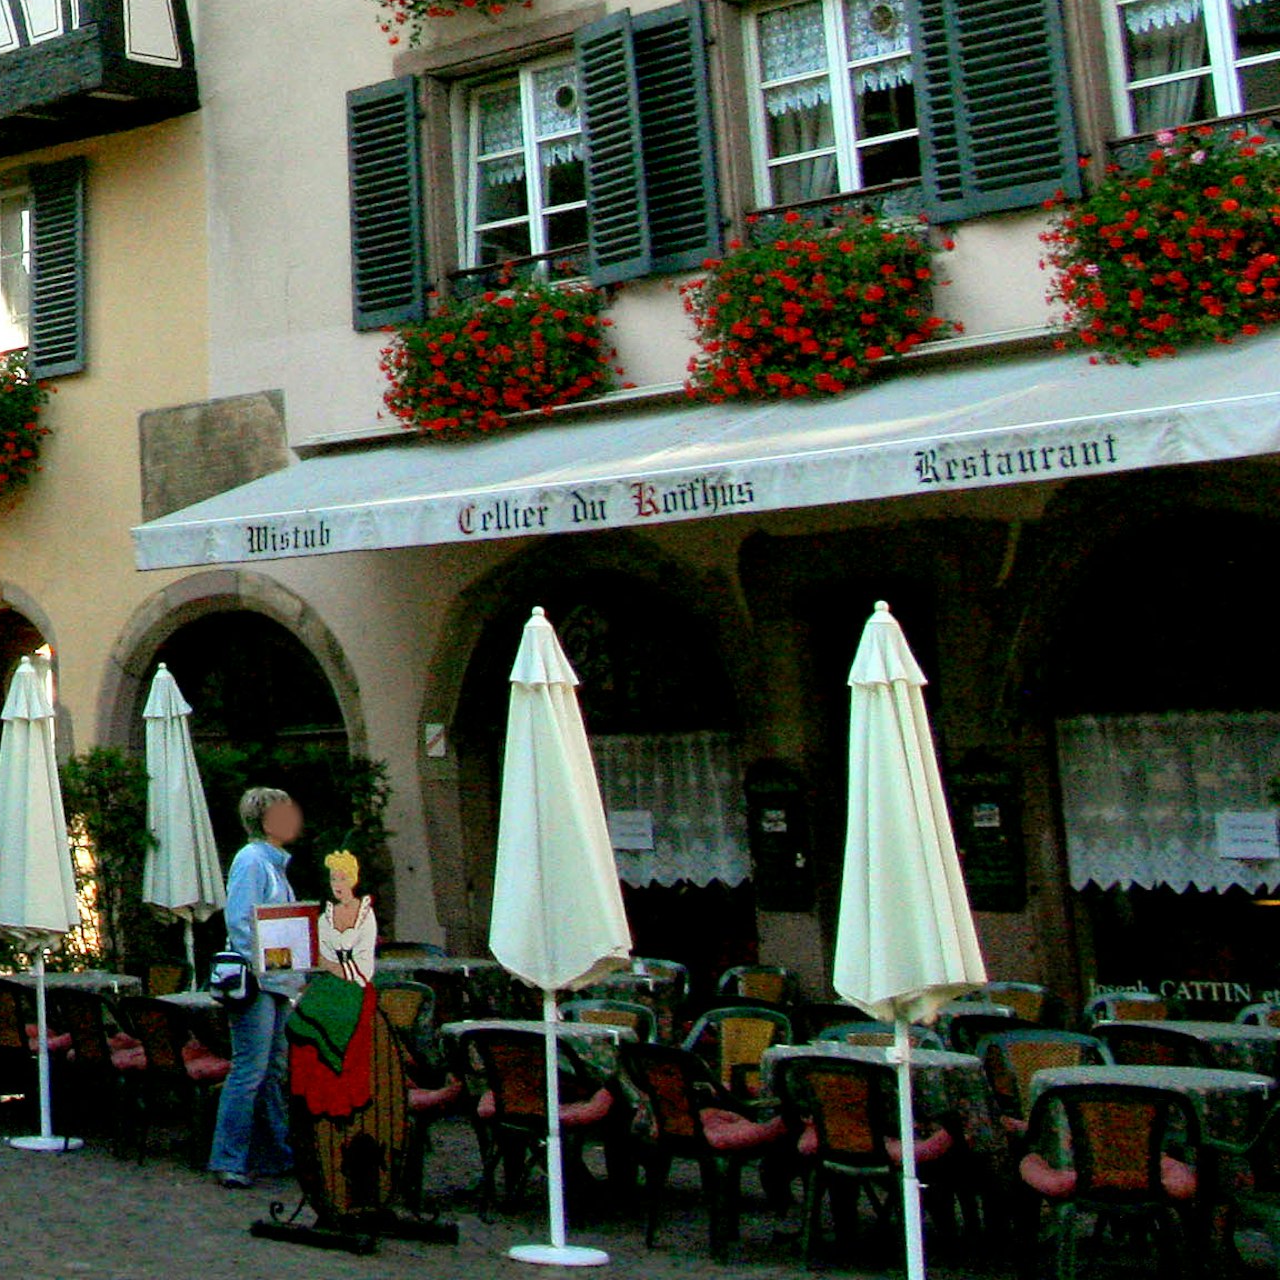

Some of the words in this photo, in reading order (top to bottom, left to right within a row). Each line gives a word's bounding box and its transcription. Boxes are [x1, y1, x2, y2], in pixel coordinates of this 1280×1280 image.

[247, 519, 331, 554] Wistub
[457, 498, 549, 535] Cellier
[571, 491, 608, 523] du
[914, 433, 1117, 484] Restaurant
[1158, 979, 1252, 1003] CATTIN
